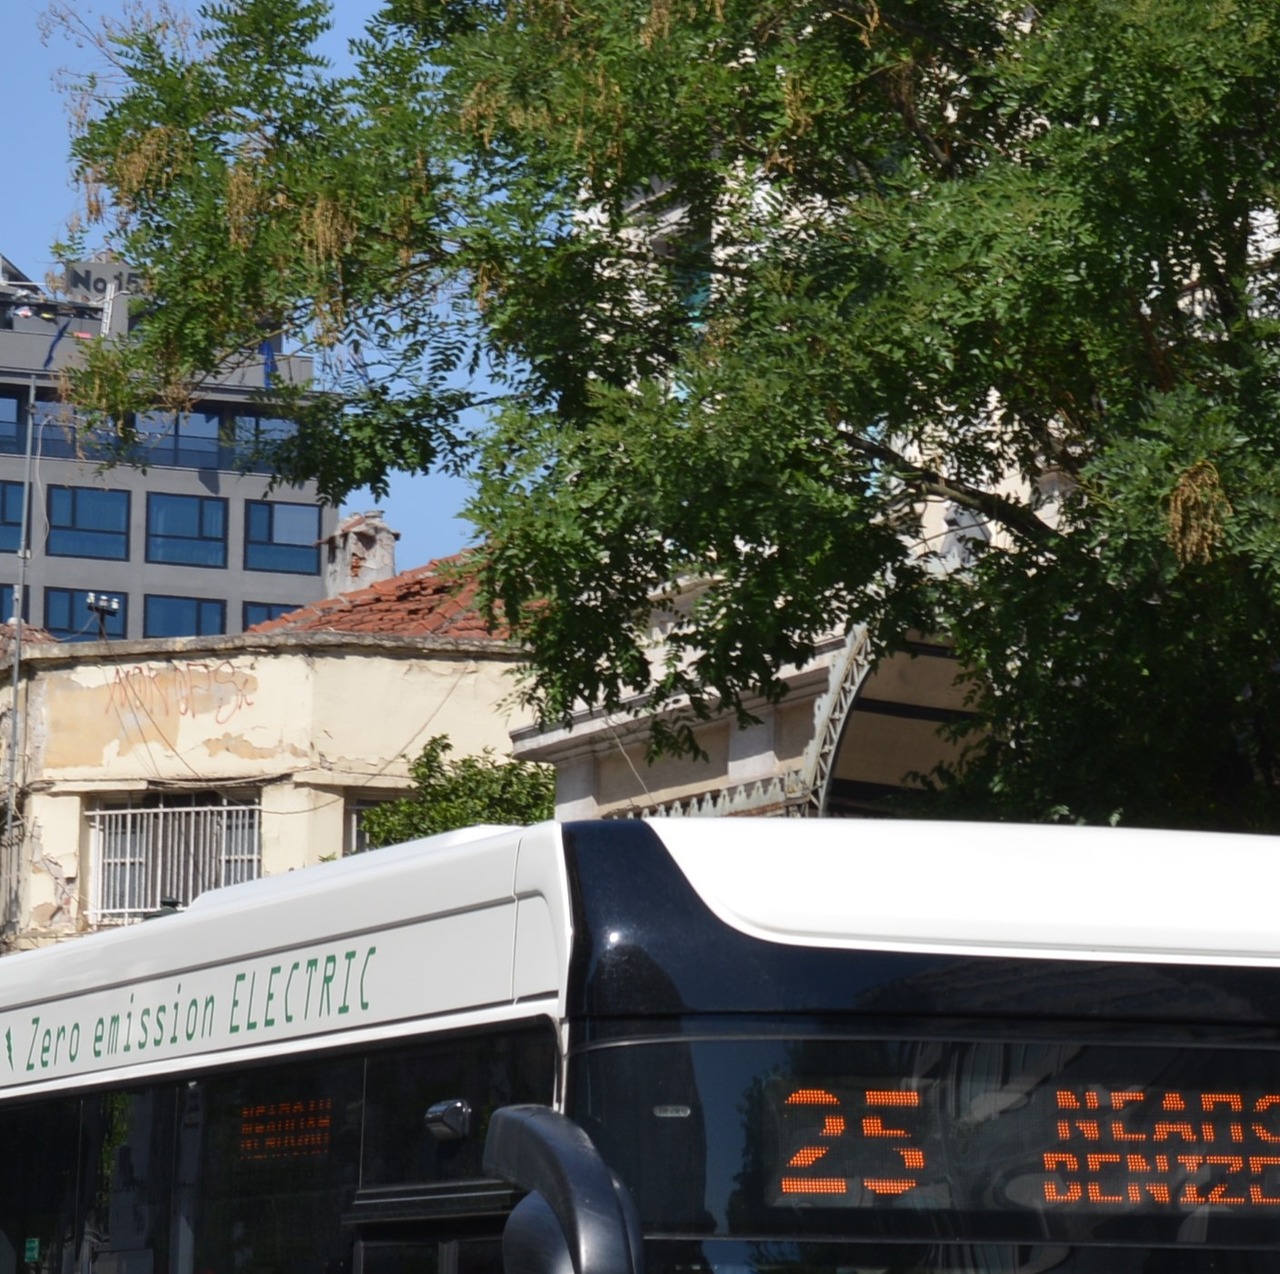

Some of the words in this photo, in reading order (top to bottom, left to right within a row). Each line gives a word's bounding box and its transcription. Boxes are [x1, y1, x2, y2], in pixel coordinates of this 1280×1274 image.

[25, 1017, 80, 1072] Zero
[92, 984, 216, 1059] emission
[228, 946, 377, 1035] ELECTRIC
[779, 1087, 925, 1196] 25
